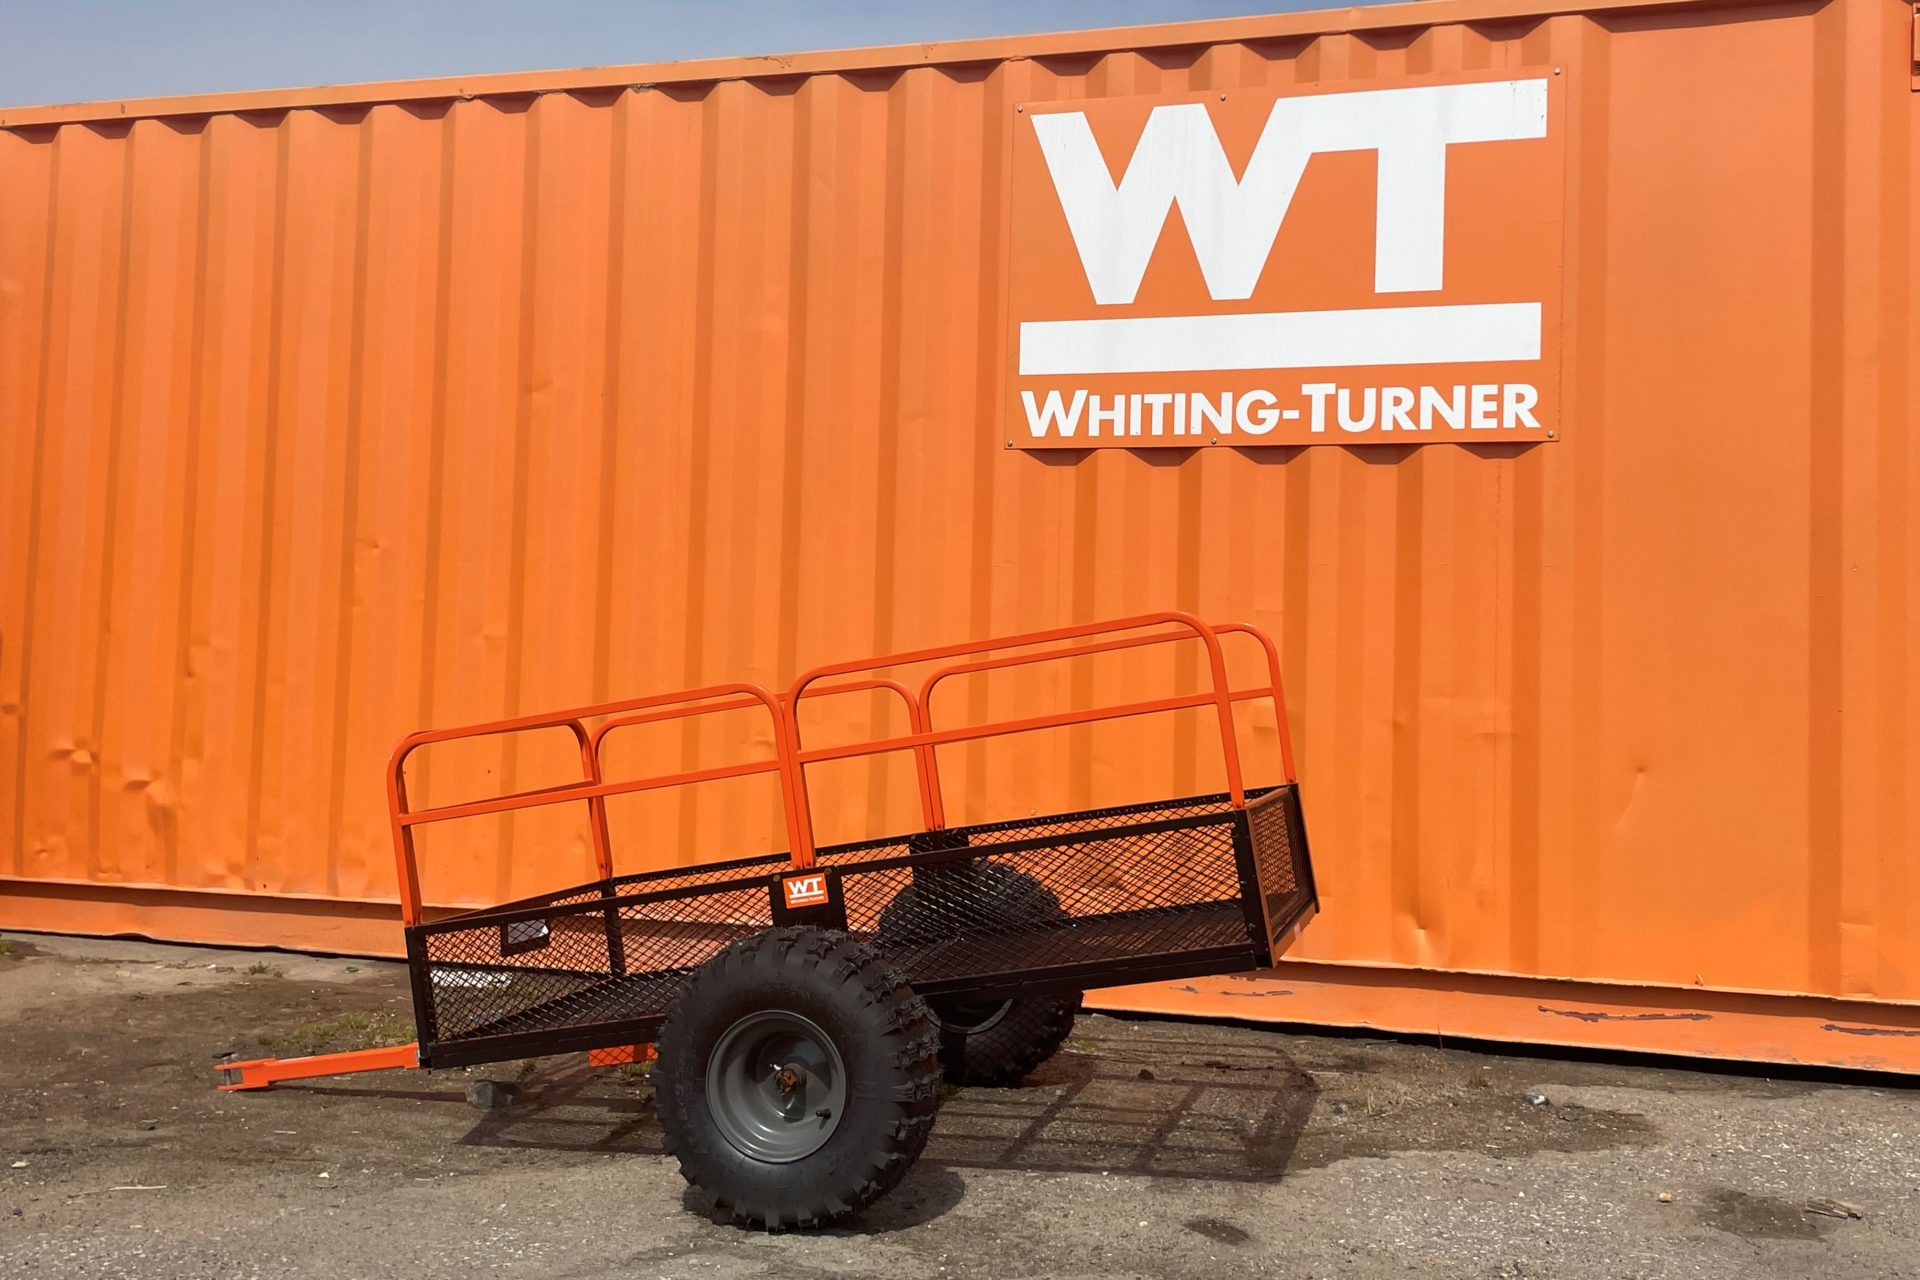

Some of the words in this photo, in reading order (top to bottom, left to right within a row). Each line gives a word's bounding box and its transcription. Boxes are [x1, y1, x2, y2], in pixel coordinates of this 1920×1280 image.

[1031, 79, 1548, 304] WT
[1021, 383, 1541, 437] WHITING-TURNER
[787, 877, 823, 895] WT
